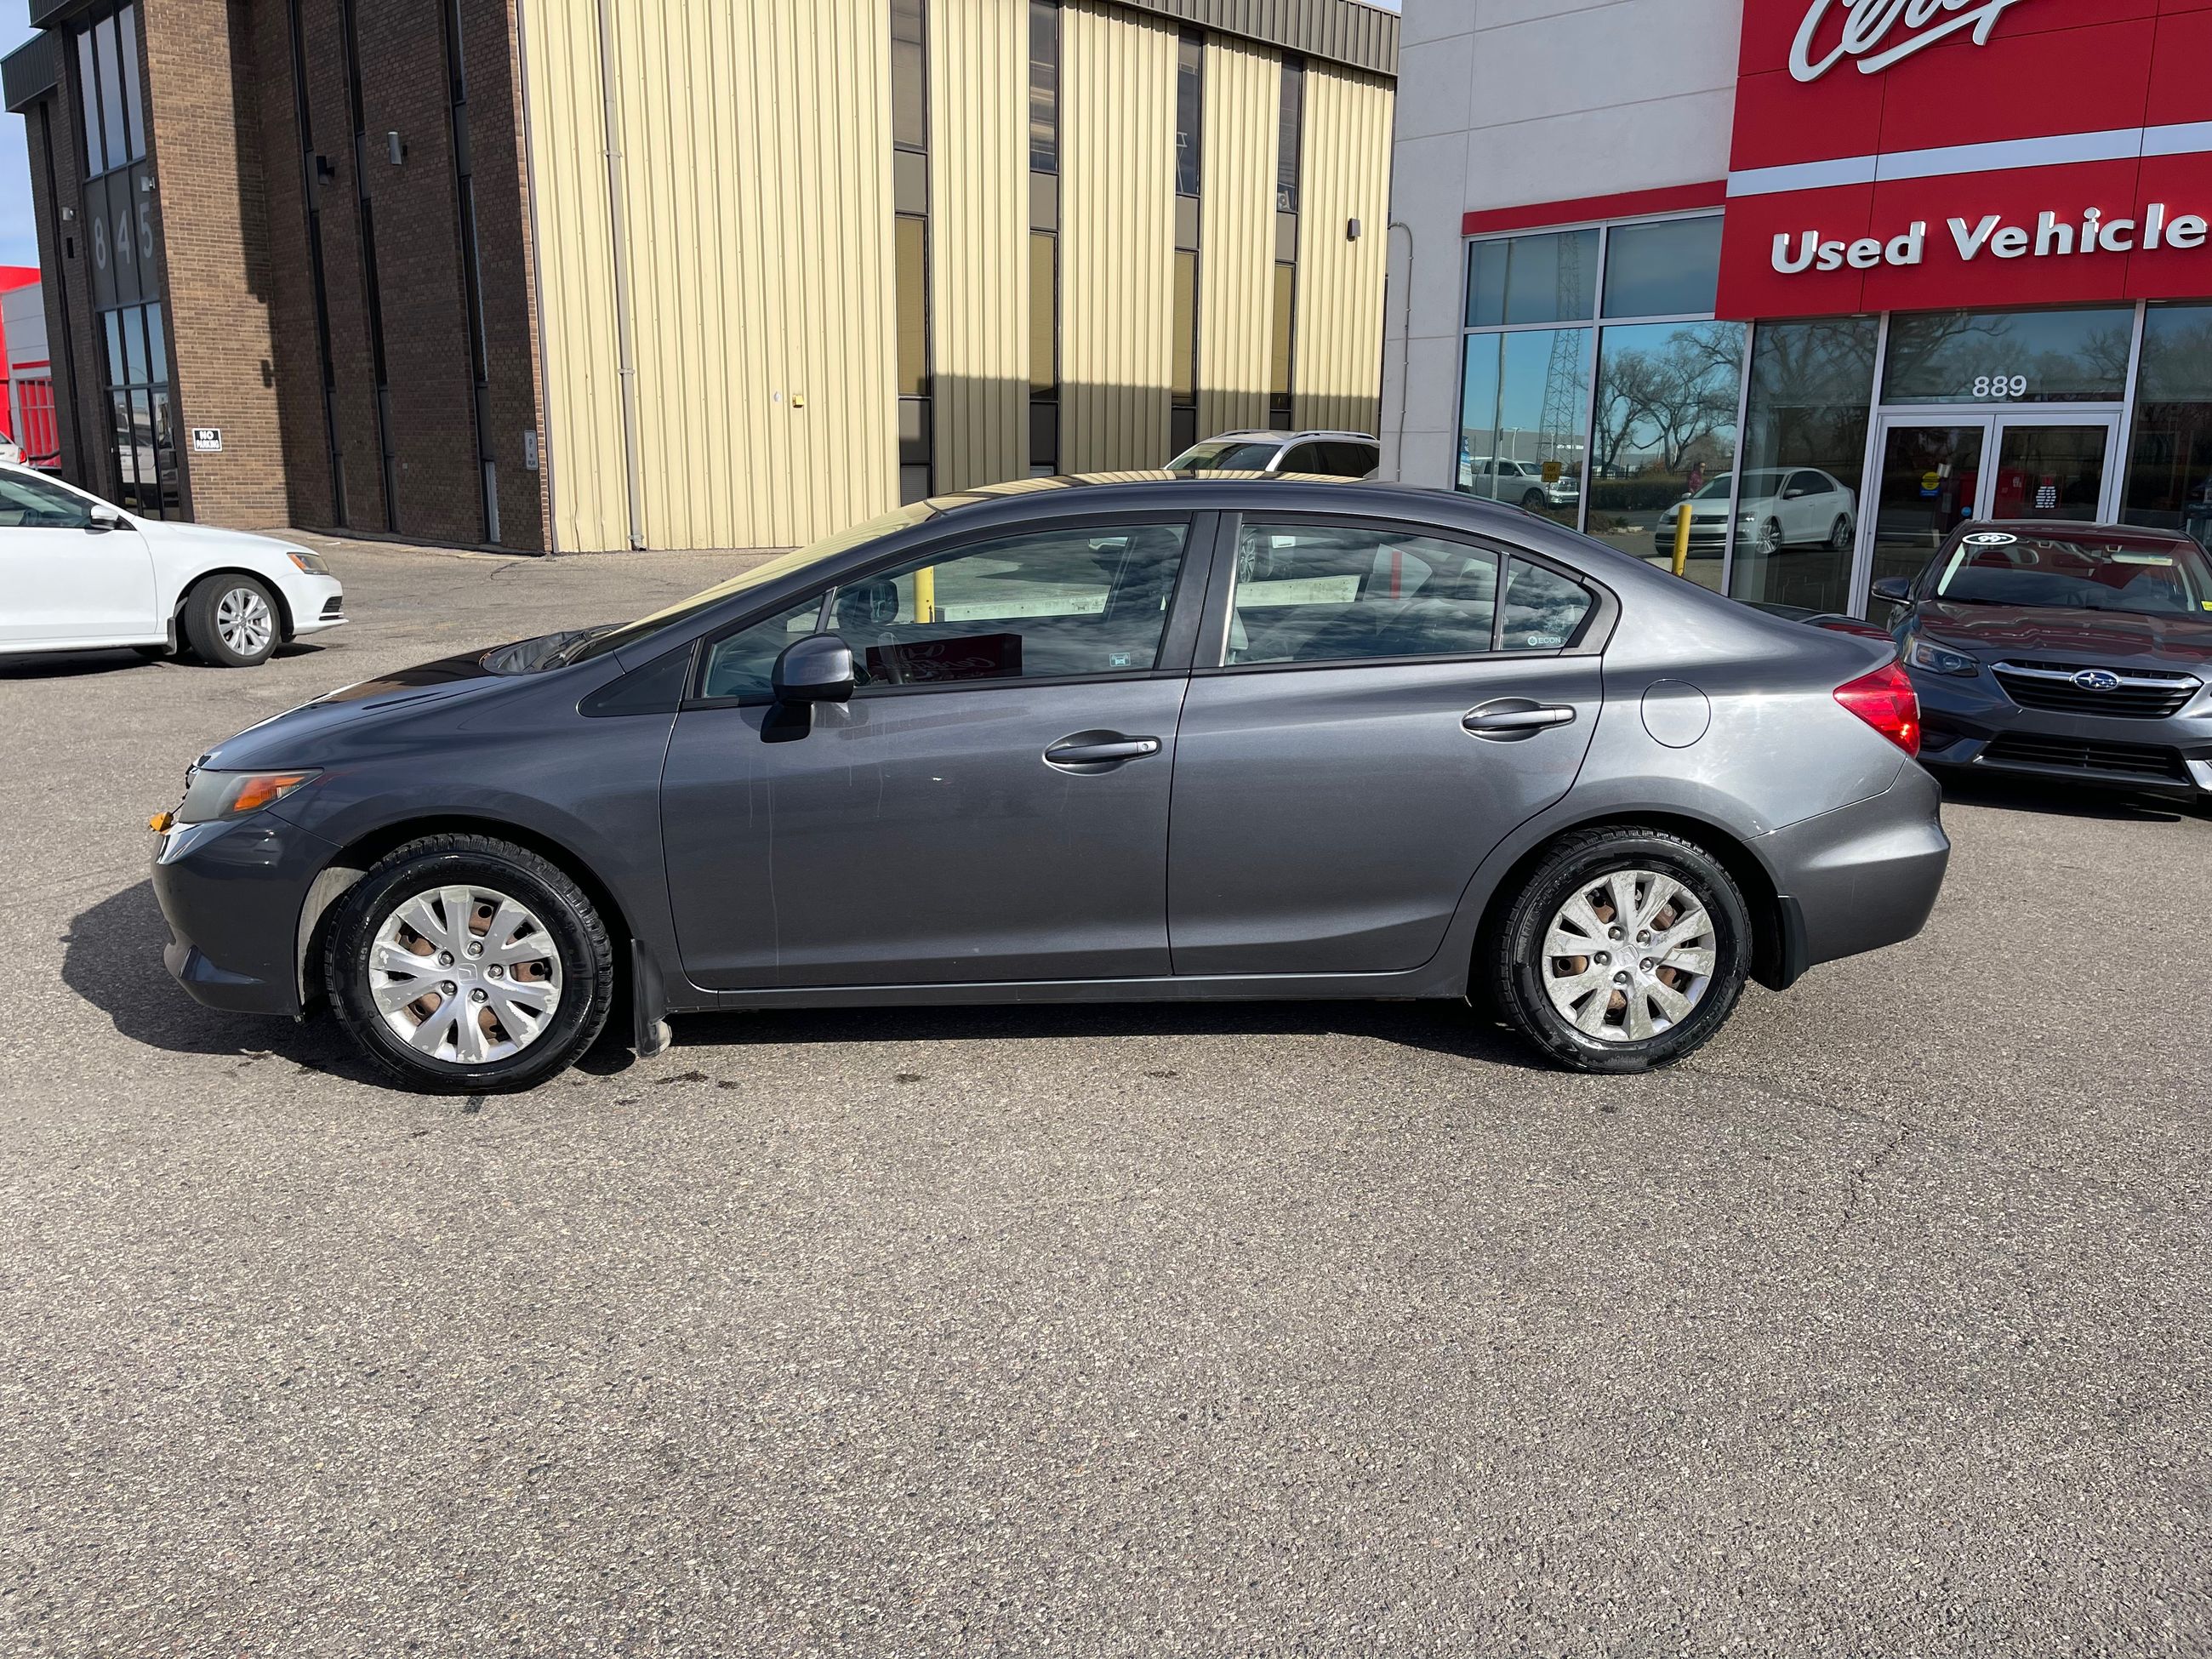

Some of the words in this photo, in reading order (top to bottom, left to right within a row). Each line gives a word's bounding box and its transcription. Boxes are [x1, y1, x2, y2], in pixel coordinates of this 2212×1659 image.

[94, 202, 153, 270] 845
[1771, 221, 1926, 274] Used
[1947, 202, 2208, 260] Vehicle
[1972, 375, 2027, 397] 889
[199, 430, 214, 440] NO
